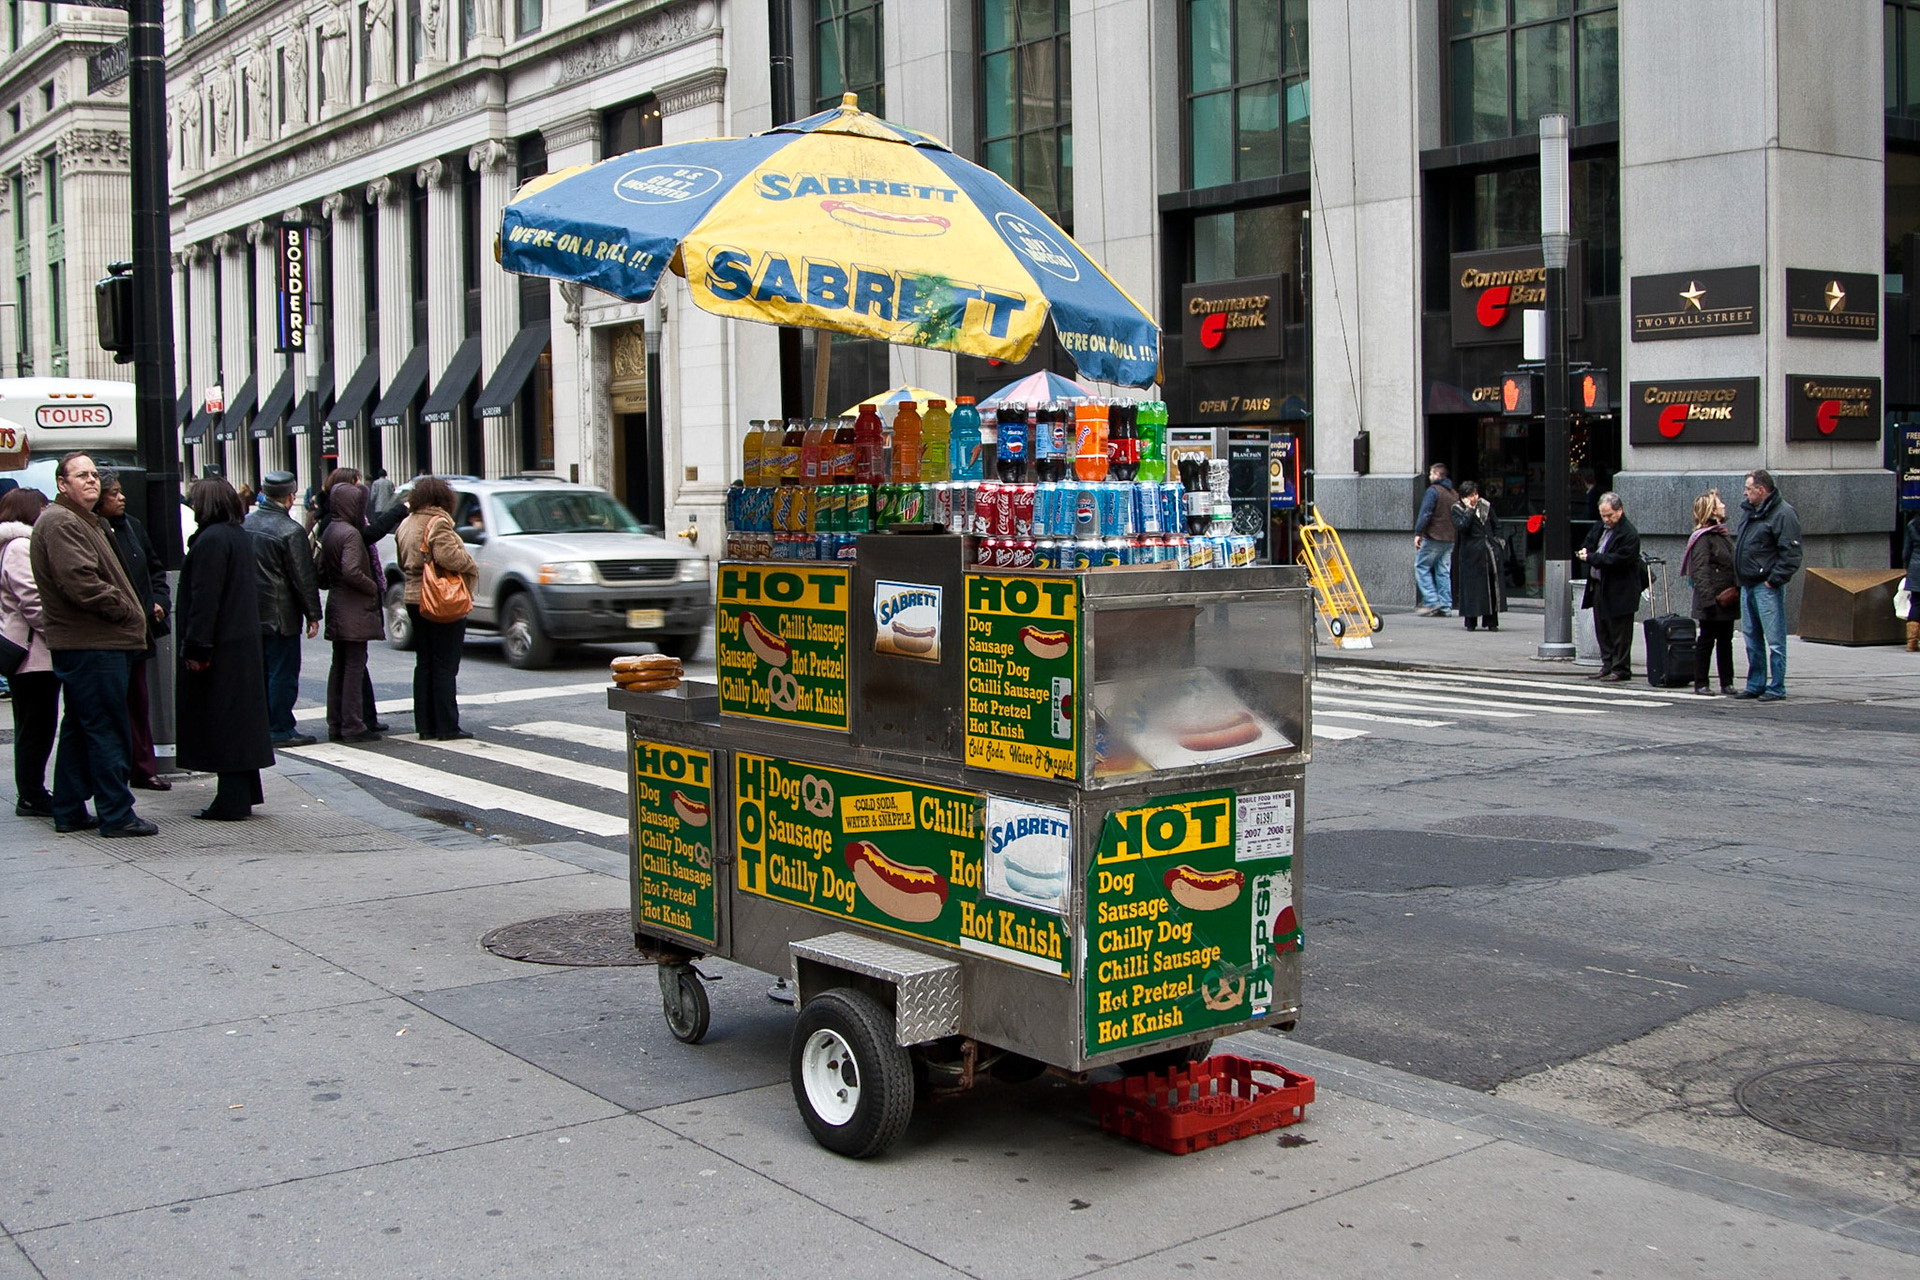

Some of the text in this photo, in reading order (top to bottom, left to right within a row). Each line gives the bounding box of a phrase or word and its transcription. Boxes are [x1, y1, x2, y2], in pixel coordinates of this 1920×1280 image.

[754, 168, 958, 202] SABRETT
[509, 225, 556, 248] WE'RE
[557, 233, 583, 254] ON
[582, 238, 594, 258] A
[286, 229, 303, 347] BORDERS
[705, 244, 1026, 339] SABRETT
[1509, 285, 1546, 305] Ban
[1189, 295, 1270, 314] Commerce
[1226, 310, 1266, 329] Bank
[1089, 334, 1107, 353] ON
[1108, 337, 1116, 354] A
[1199, 396, 1271, 413] OPEN 7 DAYS
[1472, 386, 1501, 402] OPE
[1644, 387, 1736, 404] Commerce
[1804, 381, 1872, 399] Commerce
[40, 409, 105, 423] TOURS
[1687, 402, 1732, 420] Bank
[1838, 401, 1869, 417] Bank
[1270, 440, 1291, 450] endary
[722, 570, 846, 604] HOT
[969, 578, 1073, 616] HOT
[879, 590, 937, 625] SABRETT
[720, 609, 845, 650] Dog Chilli Sausage
[969, 616, 992, 636] Dog
[720, 643, 845, 679] Sausage Hot Pretzel
[969, 636, 1014, 659] Sausage
[969, 657, 1030, 682] Chilly Dog
[722, 676, 845, 715] Chilly Dog Hot Knish
[969, 677, 1050, 704] Chilli Sausage
[969, 697, 1031, 720] Hot Pretzel
[969, 717, 1025, 739] Hot Knish
[638, 745, 708, 783] HOT
[969, 738, 984, 757] Cold
[1009, 744, 1033, 765] Water
[640, 782, 660, 807] Dog
[768, 766, 801, 811] Dog
[641, 806, 680, 834] Sausage
[855, 799, 876, 811] COLD
[920, 796, 975, 839] Chilli
[739, 756, 763, 890] HOT
[768, 810, 833, 860] Sausage
[845, 812, 911, 829] WATER & SNAPPLE
[988, 813, 1069, 854] SABRETT
[1100, 803, 1226, 859] HOT
[1244, 825, 1284, 838] 2007 2008
[642, 830, 694, 862] Chilly Dog
[643, 853, 712, 890] Chilli Sausage
[769, 853, 856, 913] Chilly Dog
[950, 849, 983, 889] Hot
[1098, 871, 1135, 896] Dog
[643, 876, 697, 907] Hot Pretzel
[644, 900, 692, 930] Hot Knish
[1098, 897, 1169, 924] Sausage
[960, 900, 1063, 960] Hot Knish
[1098, 920, 1193, 953] Chilly Dog
[1098, 945, 1221, 983] Chilli Sausage
[1098, 974, 1193, 1014] Hot Pretzel
[1098, 1005, 1183, 1044] Hot Knish
